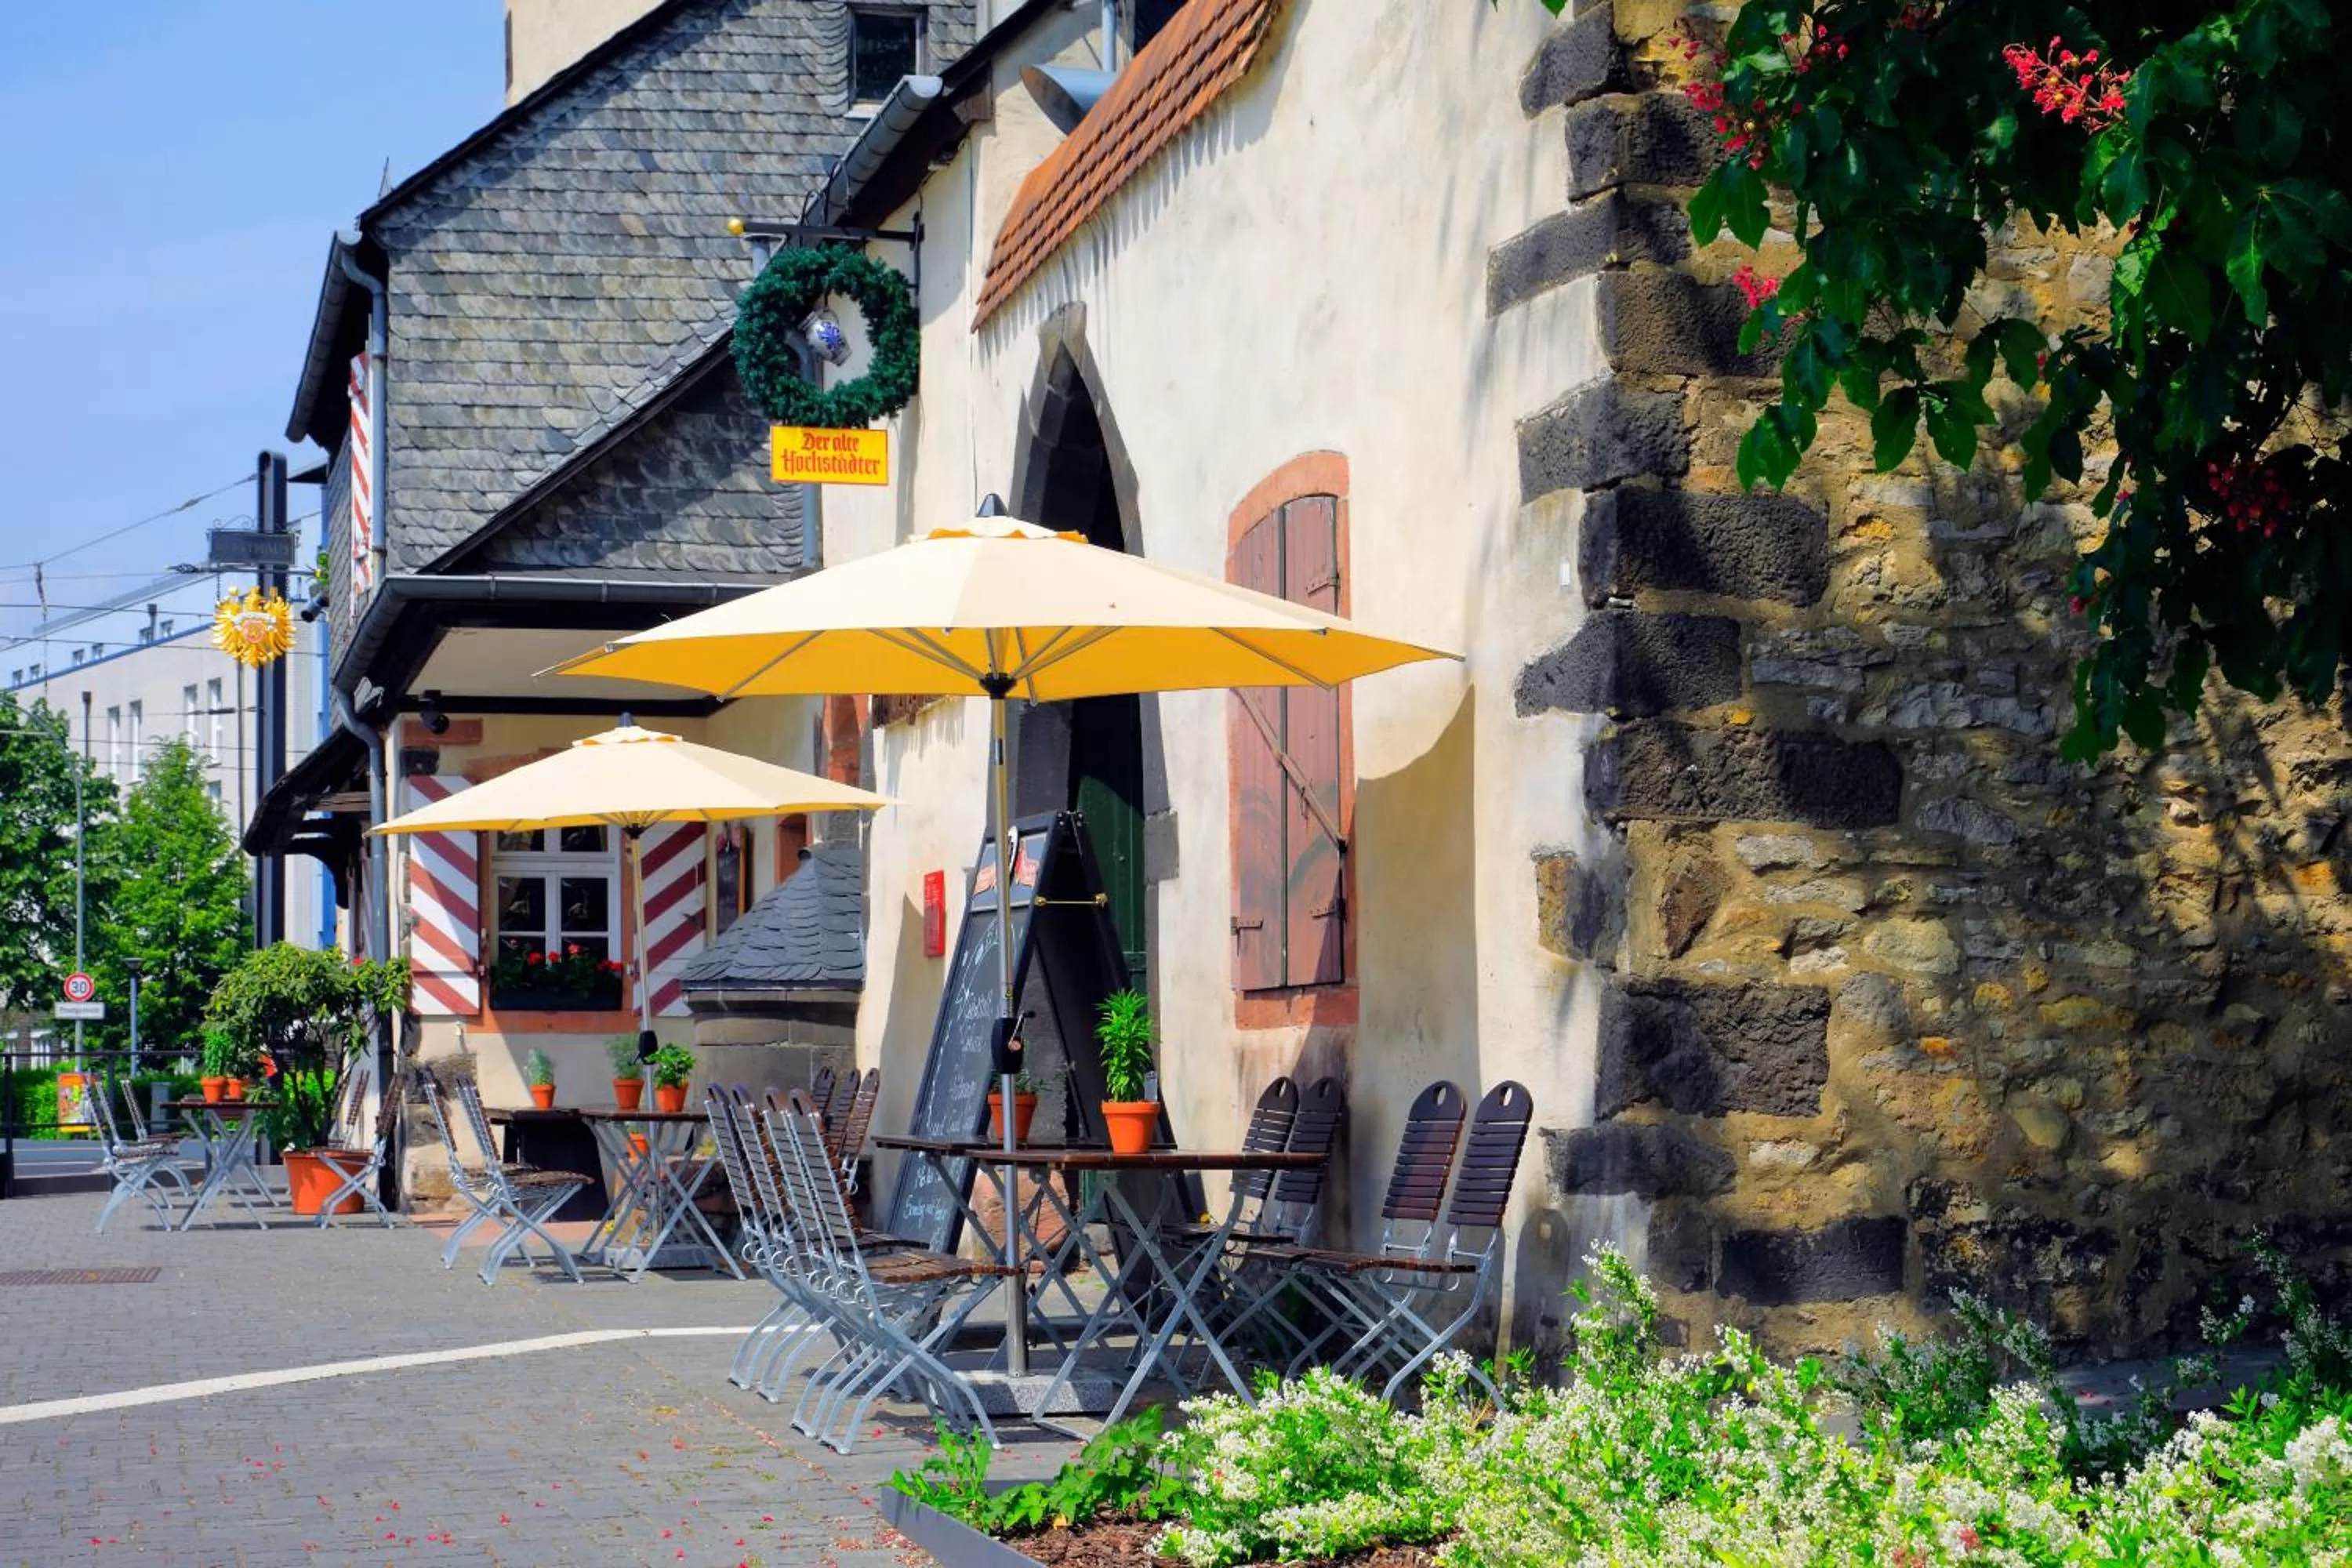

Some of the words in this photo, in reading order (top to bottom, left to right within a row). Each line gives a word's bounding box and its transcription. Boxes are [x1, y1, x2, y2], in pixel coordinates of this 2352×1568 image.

[801, 432, 830, 451] Der
[833, 433, 859, 452] alte
[71, 981, 88, 993] 30
